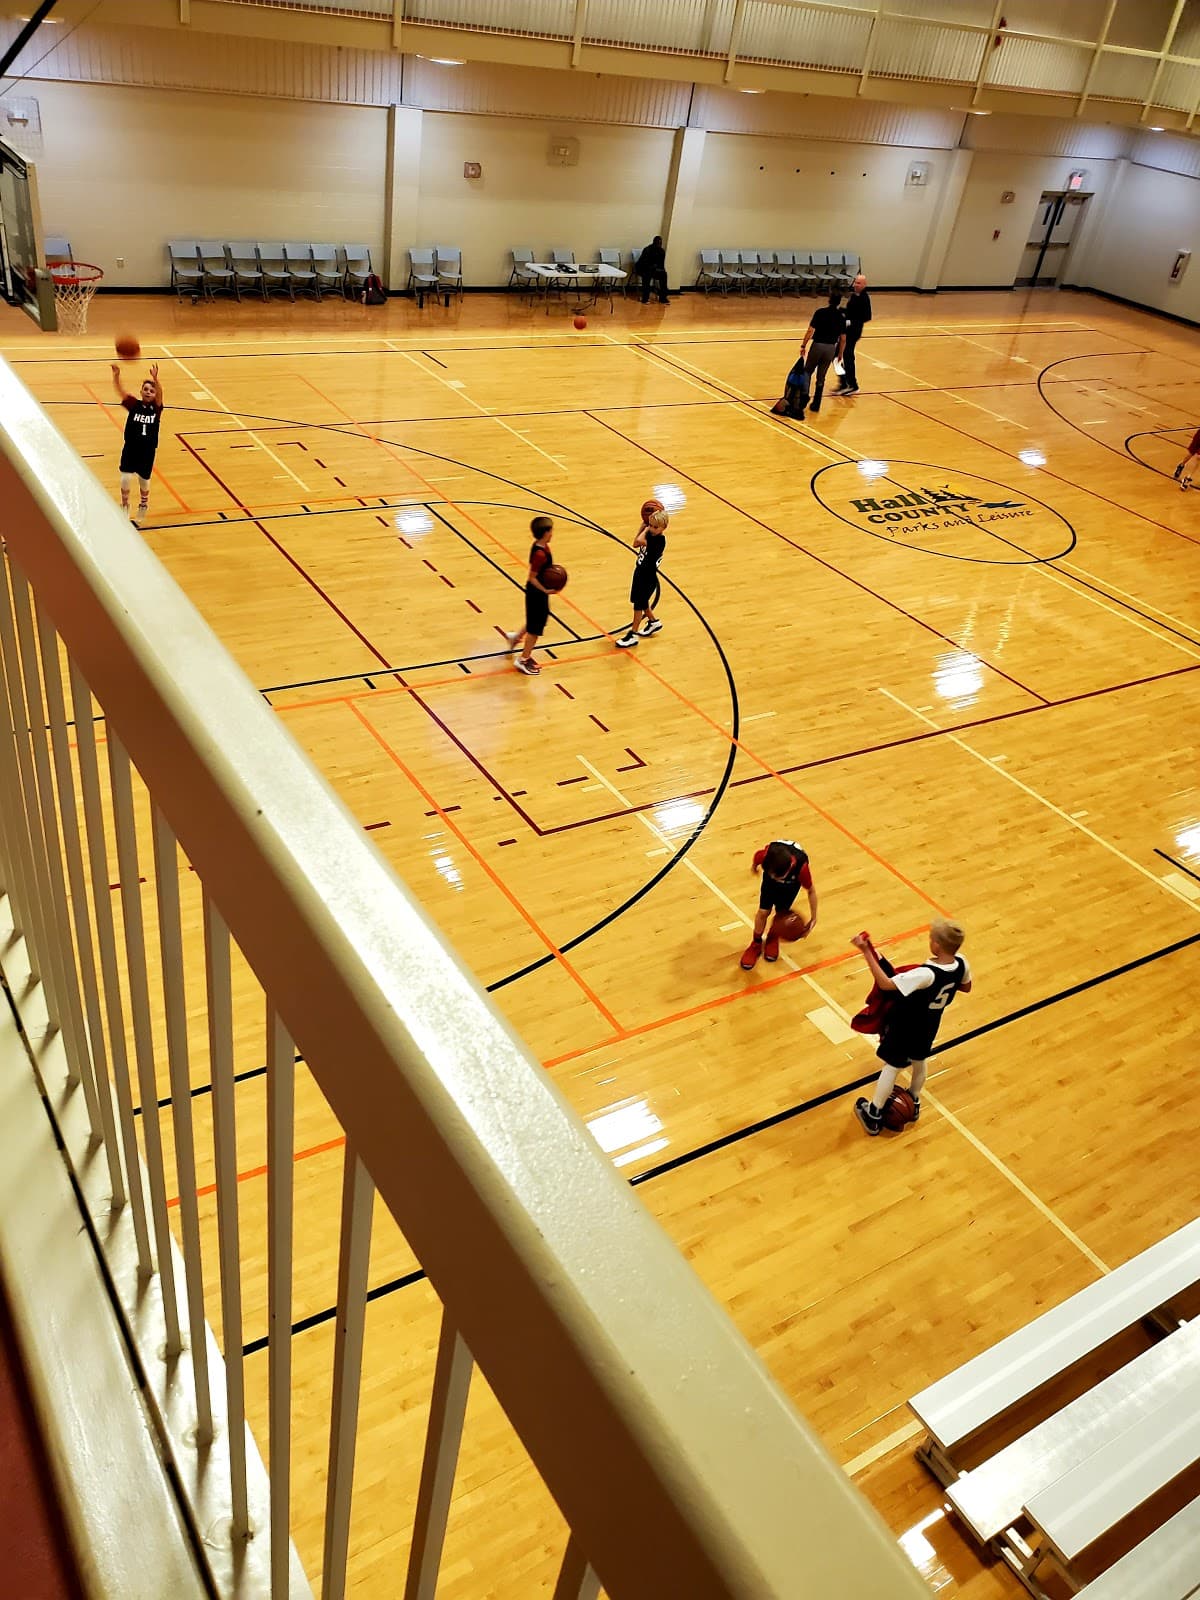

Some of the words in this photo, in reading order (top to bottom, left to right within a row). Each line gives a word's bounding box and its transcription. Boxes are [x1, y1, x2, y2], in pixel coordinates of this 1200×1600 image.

[133, 413, 157, 424] HEAT
[141, 424, 147, 436] 1
[848, 492, 928, 513] Hall
[867, 502, 970, 524] COUNTY
[886, 521, 939, 537] Parks
[943, 515, 973, 528] and
[977, 510, 1034, 523] Leisure
[928, 982, 956, 1010] 5
